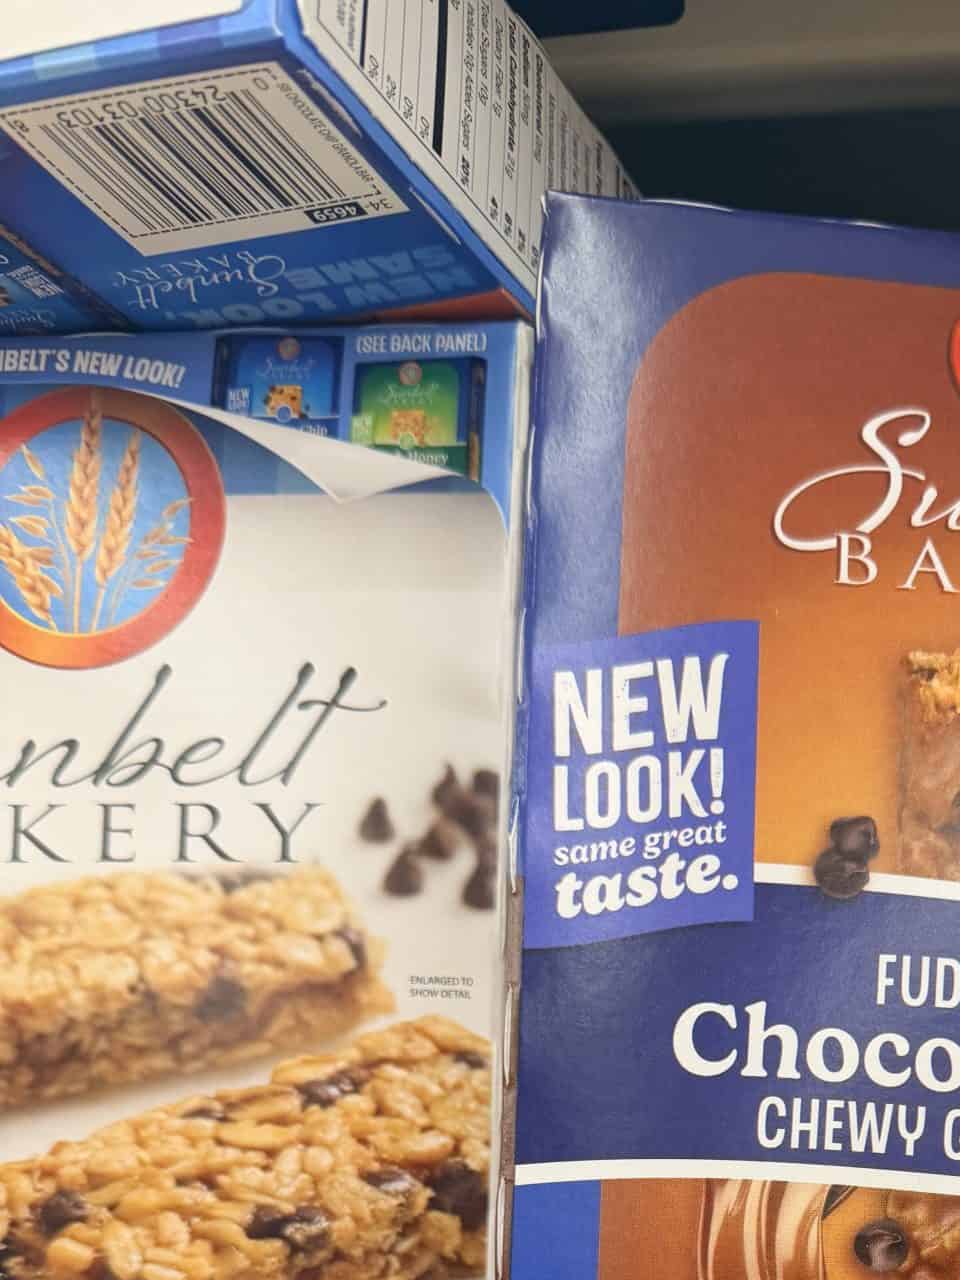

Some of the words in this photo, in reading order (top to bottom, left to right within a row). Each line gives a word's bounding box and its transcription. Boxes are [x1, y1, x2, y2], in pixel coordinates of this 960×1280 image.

[56, 100, 138, 129] 03103
[143, 84, 226, 113] 24300
[129, 254, 286, 311] Sunbelt
[0, 348, 70, 372] BELT'S
[74, 350, 122, 376] NEW
[123, 355, 187, 389] LOOK!
[356, 334, 387, 353] (SEE
[390, 333, 430, 352] BACK
[435, 332, 487, 353] PANEL)
[0, 661, 388, 789] nbelt
[553, 652, 730, 758] NEW
[552, 747, 726, 833] LOOK!
[3, 801, 328, 865] KERY
[553, 834, 636, 867] same
[642, 820, 728, 860] great
[554, 851, 739, 920] taste.
[756, 1095, 927, 1157] CHEWY
